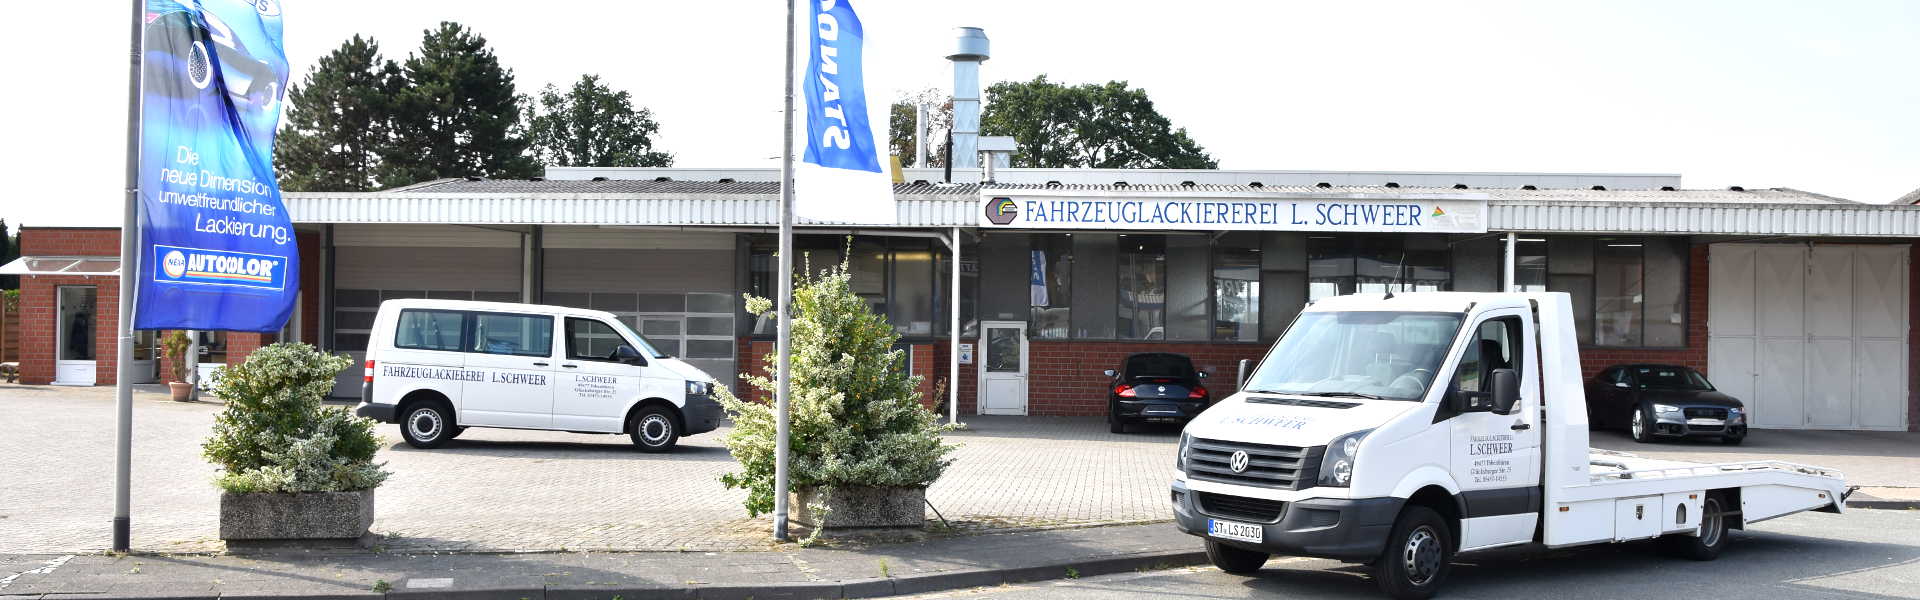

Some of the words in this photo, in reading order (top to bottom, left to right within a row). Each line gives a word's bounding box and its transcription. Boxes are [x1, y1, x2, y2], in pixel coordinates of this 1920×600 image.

[176, 145, 200, 165] Die
[160, 167, 197, 186] neue
[200, 169, 272, 198] Dimension
[159, 190, 276, 217] umweltfreundlicher
[1025, 200, 1278, 225] FAHRZEUGLACKIEREREI
[1291, 203, 1308, 225] L.
[1316, 203, 1423, 226] SCHWEER
[195, 212, 291, 245] Lackierung.
[383, 365, 485, 383] FAHRZEUGLACKIEREREI
